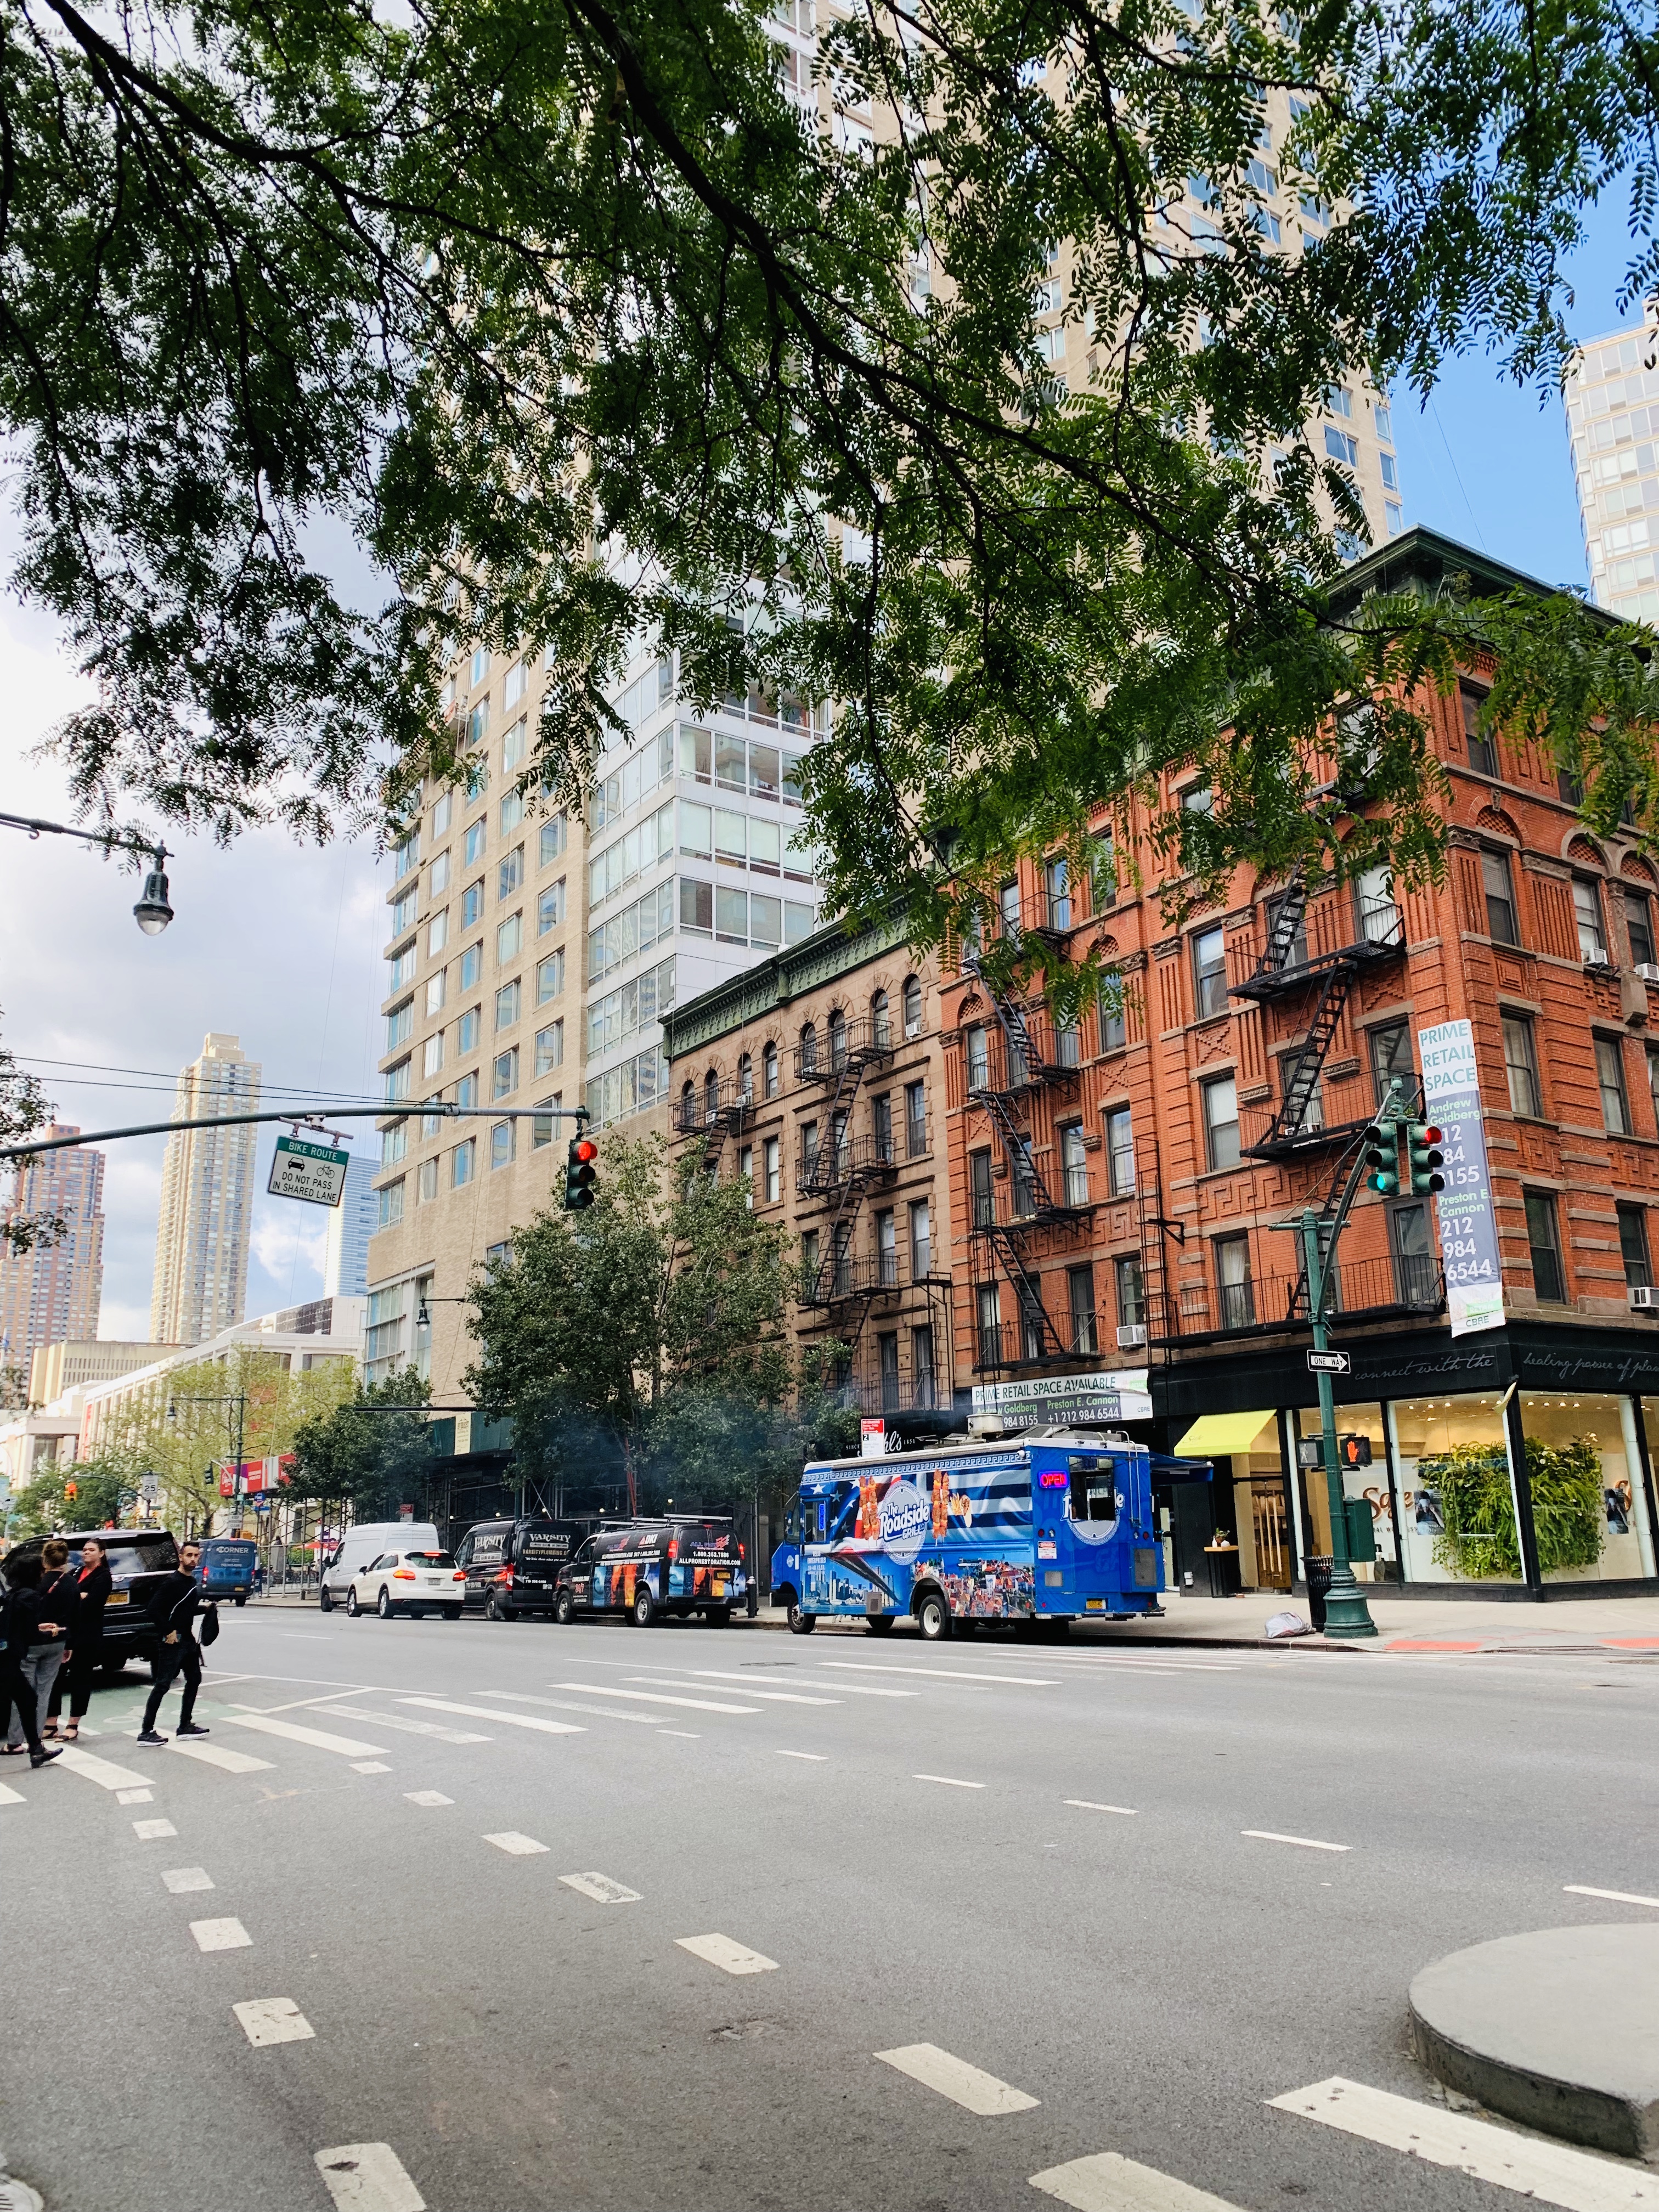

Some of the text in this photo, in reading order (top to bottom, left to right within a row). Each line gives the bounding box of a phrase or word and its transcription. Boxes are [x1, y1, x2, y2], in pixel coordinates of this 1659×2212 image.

[1420, 1022, 1468, 1046] PRIME
[1423, 1045, 1474, 1069] RETAIL
[1425, 1068, 1475, 1091] SPACE
[1429, 1099, 1471, 1115] Andrew
[1430, 1110, 1481, 1126] Goldberg
[1432, 1125, 1462, 1146] 12
[289, 1142, 338, 1160] BIKE ROUTE
[1438, 1145, 1465, 1165] 84
[282, 1172, 332, 1189] DO NOT PASS
[273, 1181, 280, 1189] IN
[283, 1183, 314, 1197] SHARED
[317, 1190, 337, 1201] LANE
[1439, 1188, 1491, 1206] Preston E.
[1440, 1204, 1485, 1218] Cannon
[1441, 1216, 1474, 1238] 212
[1444, 1238, 1476, 1259] 984
[1447, 1259, 1492, 1281] 6544
[1466, 1316, 1489, 1327] CBRE
[1331, 1358, 1343, 1366] WAY
[1355, 1353, 1494, 1380] connect with the
[1523, 1352, 1572, 1379] healing
[1572, 1358, 1614, 1375] power
[1617, 1358, 1630, 1382] of
[975, 1376, 1115, 1402] PRIME RETAIL SPACE AVAILABLE
[1005, 1402, 1037, 1414] Goldberg
[1047, 1396, 1118, 1410] Preston E. Cannon
[1003, 1414, 1038, 1427] 984 8155
[1048, 1407, 1120, 1424] +1 212 984 6544
[1040, 1474, 1065, 1486] OPEN
[887, 1502, 899, 1517] The
[1363, 1487, 1414, 1520] Sae
[878, 1498, 930, 1541] Roadside
[529, 1534, 571, 1543] VARSITY
[645, 1534, 658, 1544] DKI
[902, 1525, 923, 1539] GRILL
[475, 1534, 506, 1551] VARSITY
